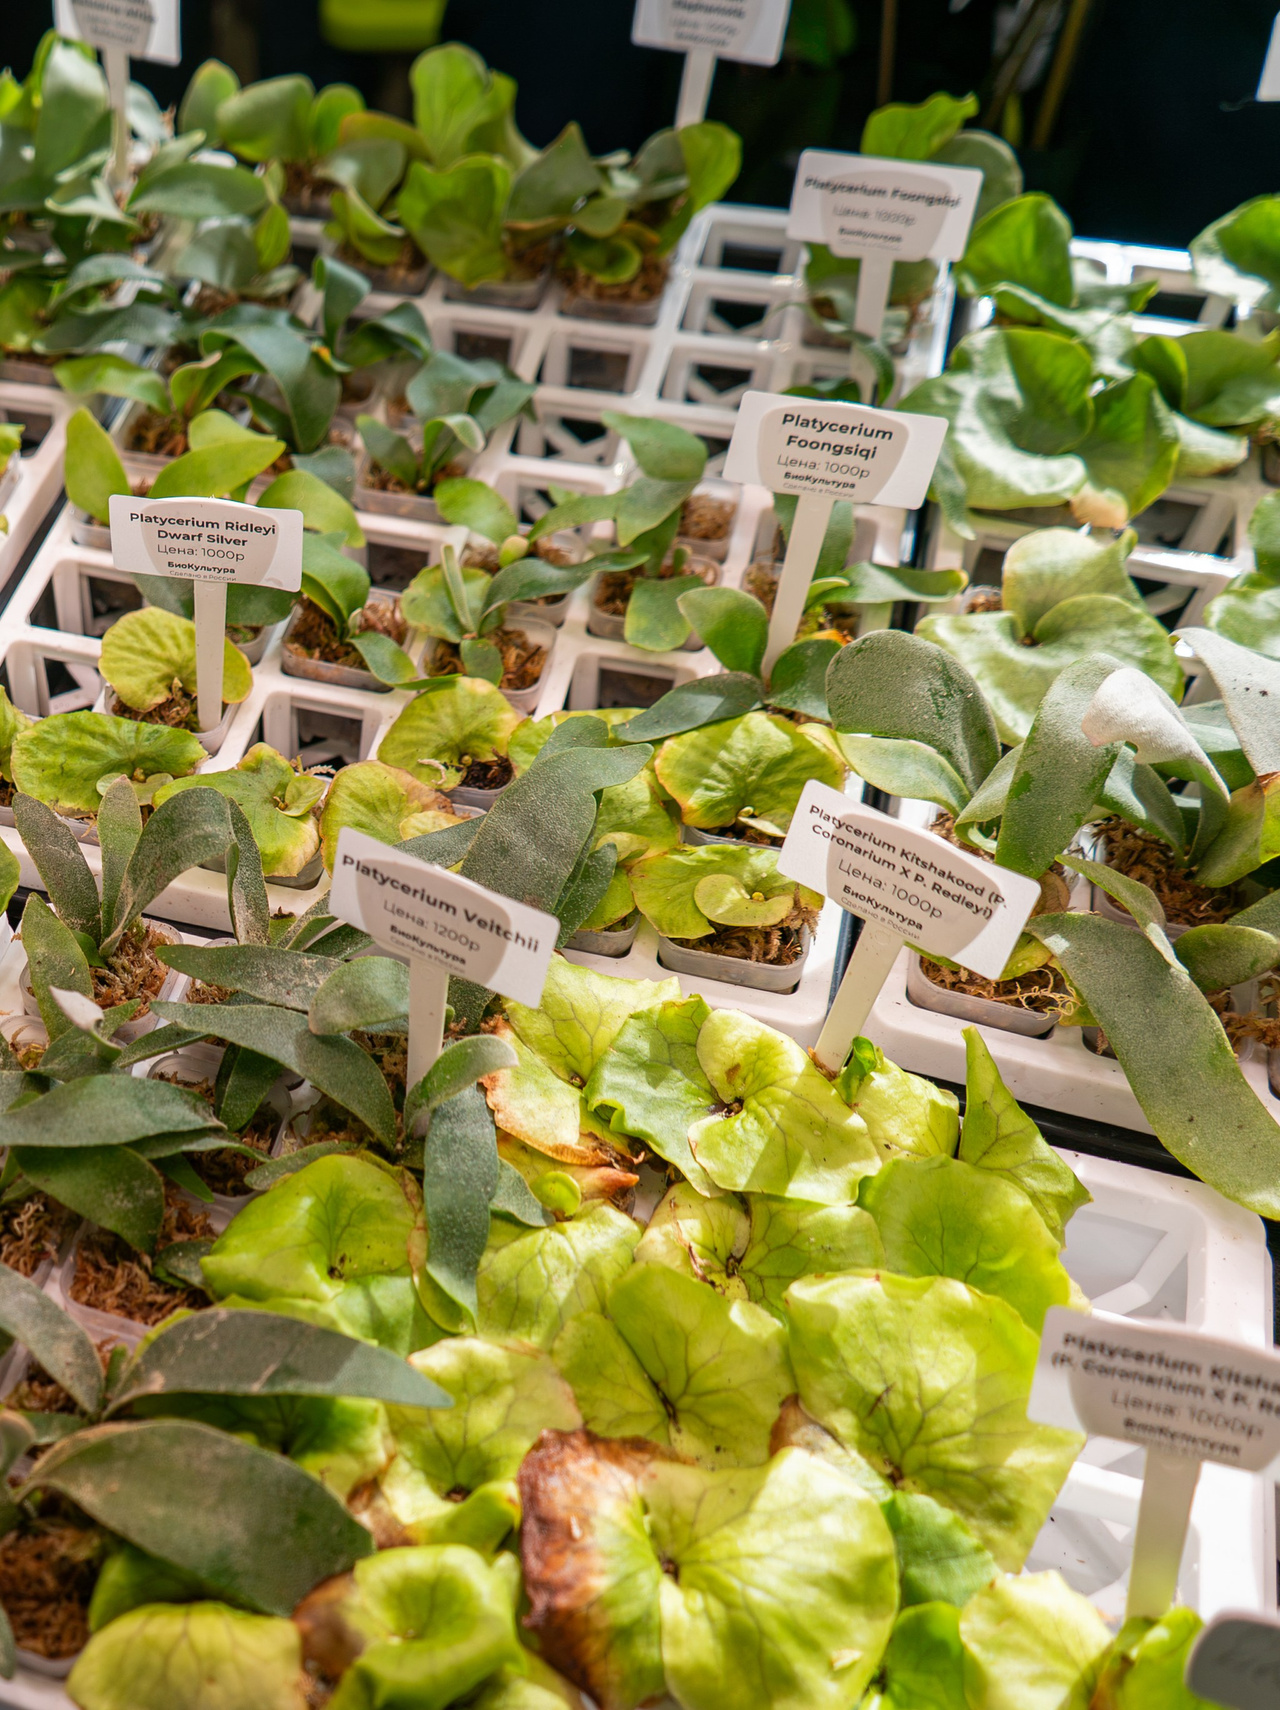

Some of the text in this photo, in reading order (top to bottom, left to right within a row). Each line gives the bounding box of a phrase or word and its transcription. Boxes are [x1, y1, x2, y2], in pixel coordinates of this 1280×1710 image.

[782, 413, 893, 441] Platycerium
[777, 454, 870, 480] Цена: 1000р
[786, 435, 878, 461] Foongsiqi
[784, 472, 856, 490] БиоКультура
[130, 512, 276, 535] Platycerium Ridleyi
[157, 529, 248, 547] Dwarf Silver
[157, 544, 245, 562] Цена: 1000р
[167, 561, 236, 574] БиоКультура
[809, 804, 1008, 908] Platycerium Kitshakood (P.
[812, 824, 994, 921] Coronarium X P. Redleyi)
[343, 854, 539, 953] Platycerium Veitchii
[838, 858, 943, 919] Цена: 1000р
[842, 885, 923, 931] БиоКультура
[383, 899, 480, 952] Цена: 1200р
[390, 924, 466, 965] БиоКультура
[1063, 1332, 1202, 1377] Platycerium
[1081, 1358, 1205, 1397] Coronarium
